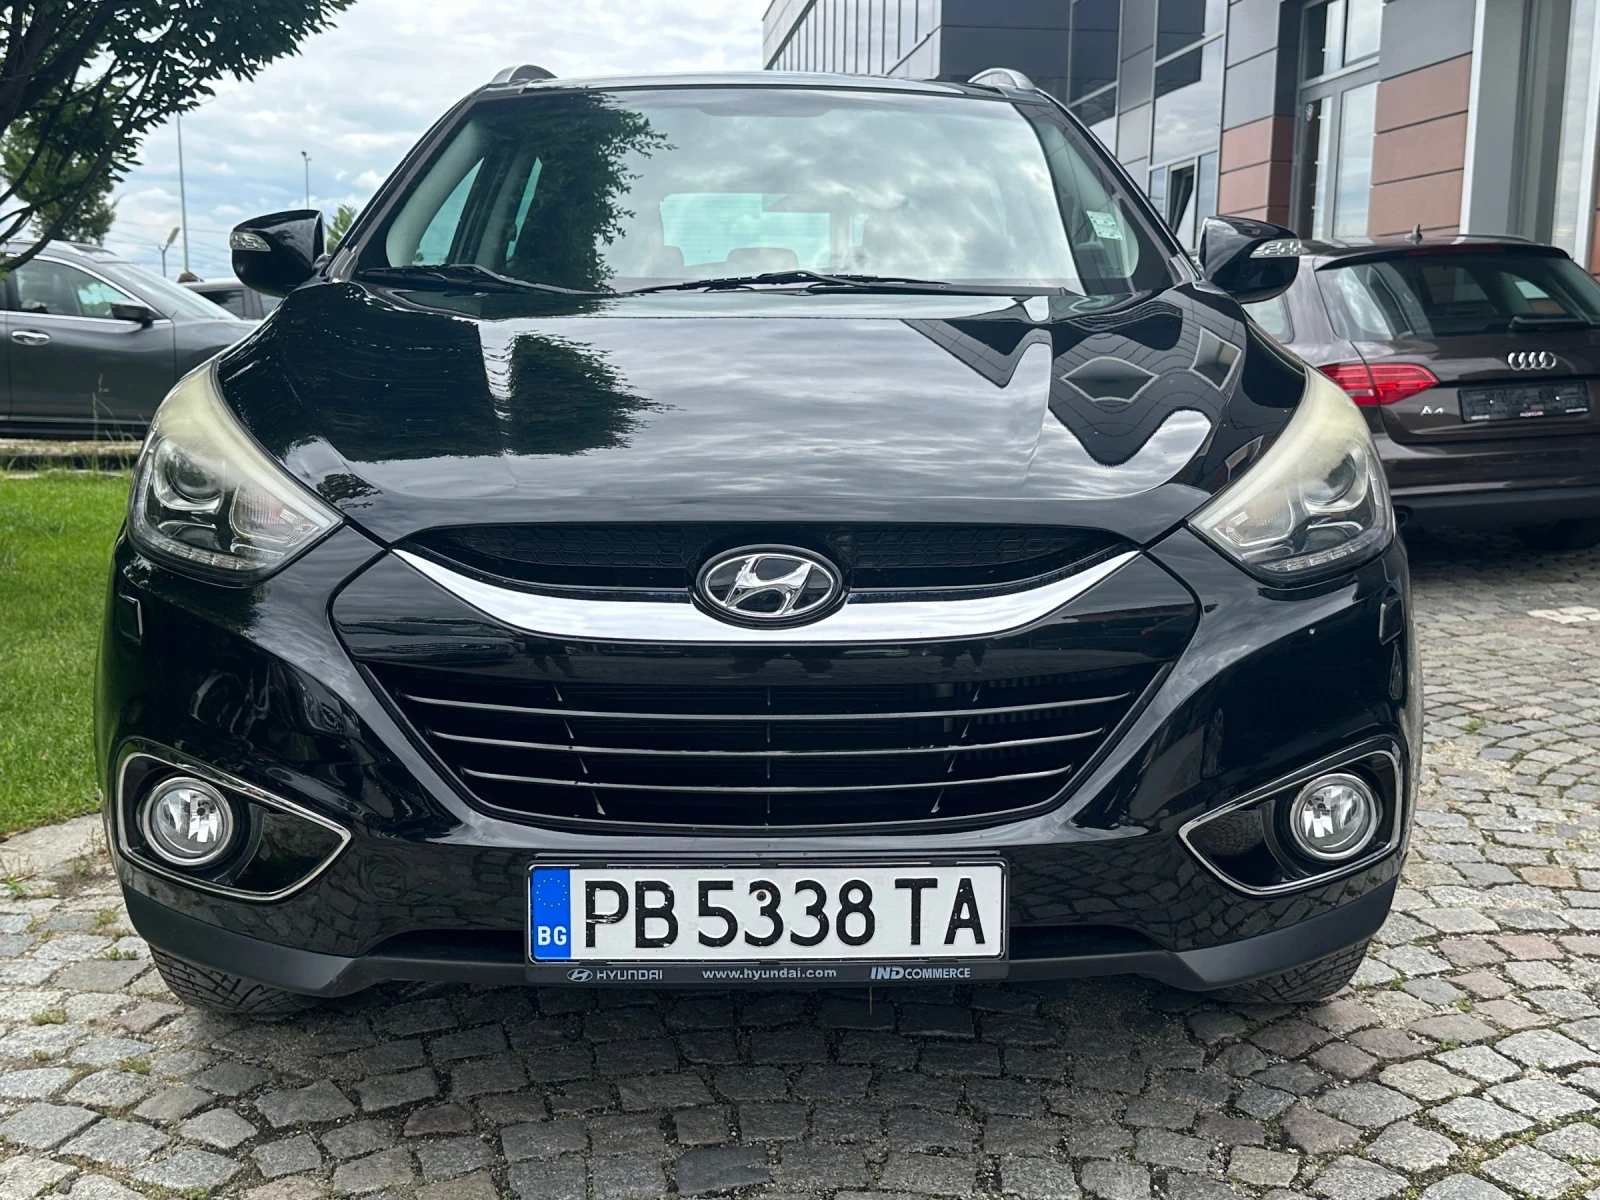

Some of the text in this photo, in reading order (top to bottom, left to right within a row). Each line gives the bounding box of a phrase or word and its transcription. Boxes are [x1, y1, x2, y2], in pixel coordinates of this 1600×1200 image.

[584, 878, 986, 949] PB 5338 TA
[537, 926, 567, 947] BG
[596, 969, 663, 980] HYUNDAI
[701, 968, 837, 981] www.hyundai.com
